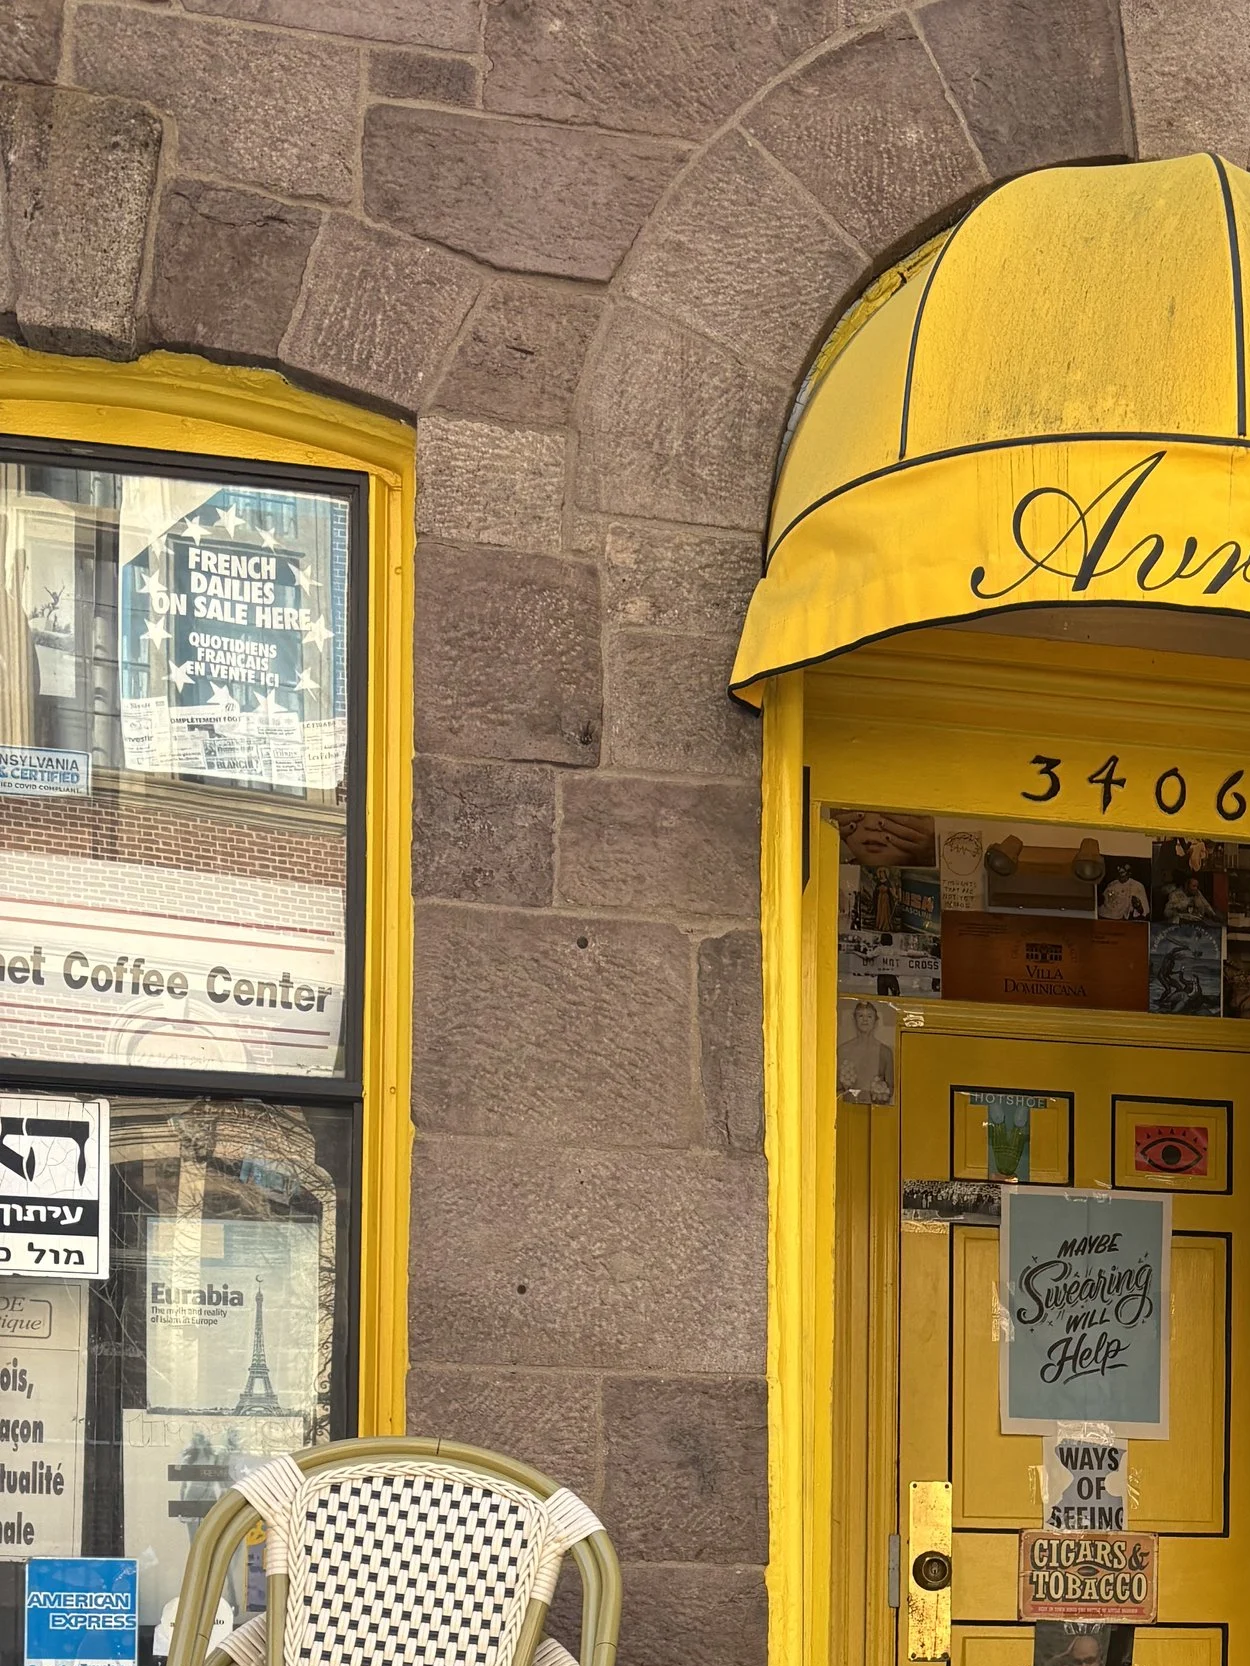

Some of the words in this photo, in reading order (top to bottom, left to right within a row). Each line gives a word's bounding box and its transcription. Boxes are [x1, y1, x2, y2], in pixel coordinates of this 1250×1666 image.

[188, 547, 276, 580] FRENCH
[190, 571, 275, 605] DAILIES
[152, 592, 187, 616] ON
[194, 596, 248, 625] SALE
[255, 606, 312, 631] HERE
[188, 631, 277, 659] QUOTIDIENS
[186, 660, 205, 676] EN
[210, 663, 256, 684] VENTE
[260, 672, 279, 688] ICI
[10, 768, 80, 784] CERTIFIED
[15, 782, 37, 790] COVID
[1021, 755, 1247, 821] 3406
[882, 957, 899, 968] NOT
[908, 959, 939, 970] CROSS
[1025, 965, 1064, 980] VILLA
[63, 951, 189, 1000] Coffee
[206, 966, 333, 1013] Center
[1003, 978, 1086, 997] DOMINICANA
[974, 1092, 1046, 1108] HOTSHOE
[27, 1241, 85, 1265] מול
[1056, 1233, 1123, 1258] MAYBE
[151, 1282, 244, 1307] Eurabia
[1017, 1260, 1153, 1328] Swearing
[150, 1315, 159, 1323] of
[191, 1317, 218, 1327] Europe
[151, 1306, 165, 1315] The
[188, 1307, 202, 1316] and
[203, 1308, 227, 1318] reality
[1066, 1308, 1110, 1334] WILL
[1040, 1332, 1131, 1383] Help
[1059, 1446, 1120, 1471] WAYS
[1076, 1476, 1106, 1501] OF
[1032, 1538, 1128, 1570] CIGARS
[1128, 1543, 1150, 1571] &
[1031, 1570, 1148, 1603] TOBACCO
[27, 1592, 131, 1610] AMERICAN
[49, 1613, 136, 1630] EXPRESS
